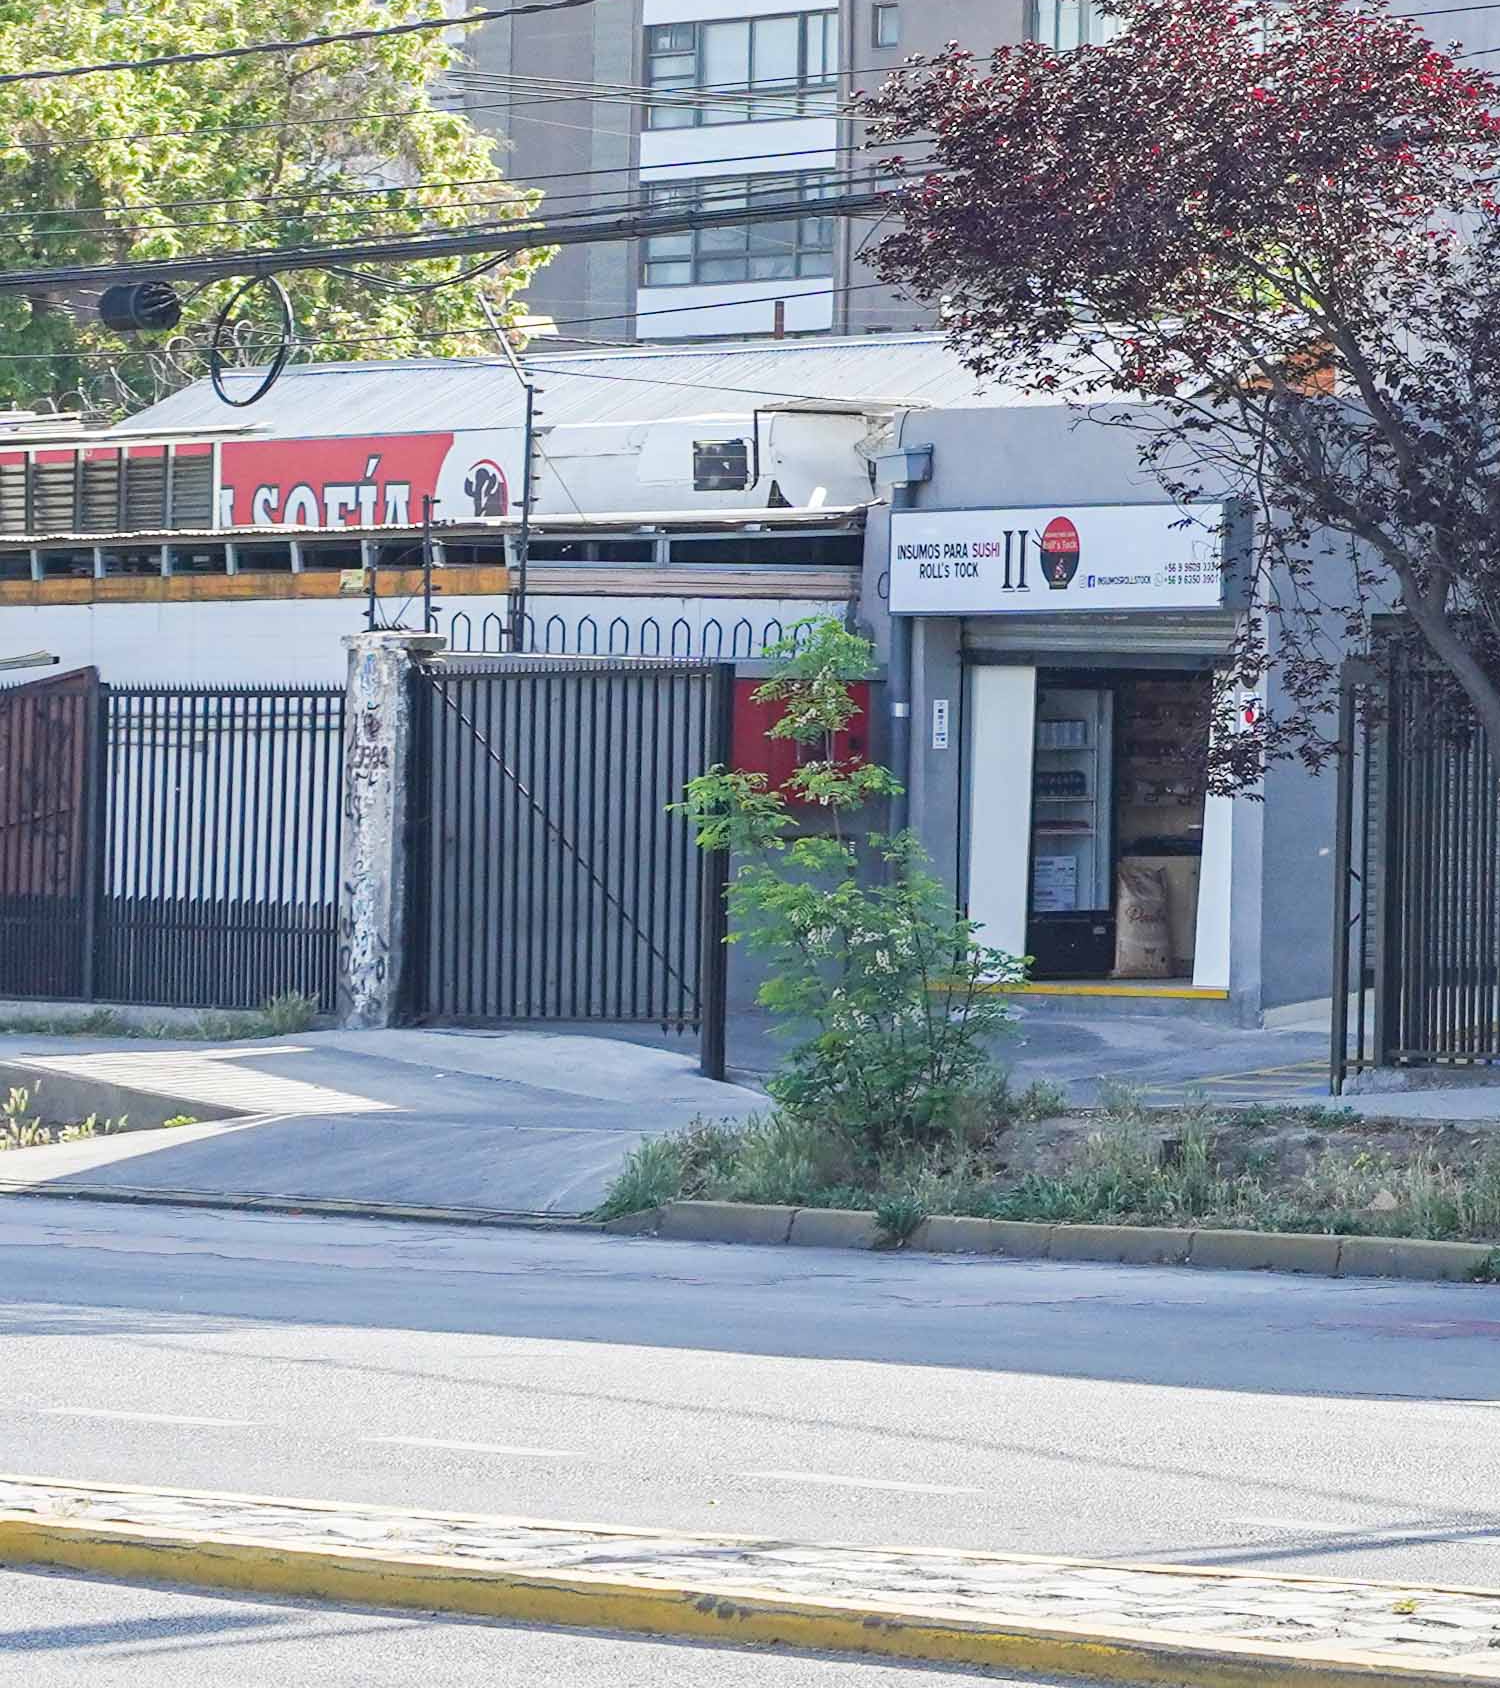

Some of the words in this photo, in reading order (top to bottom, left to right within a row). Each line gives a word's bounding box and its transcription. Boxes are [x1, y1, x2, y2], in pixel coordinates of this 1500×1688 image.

[897, 544, 941, 560] INSUMOS
[943, 543, 969, 559] PARA
[972, 542, 1000, 558] SUSHI
[954, 562, 979, 578] TOCK
